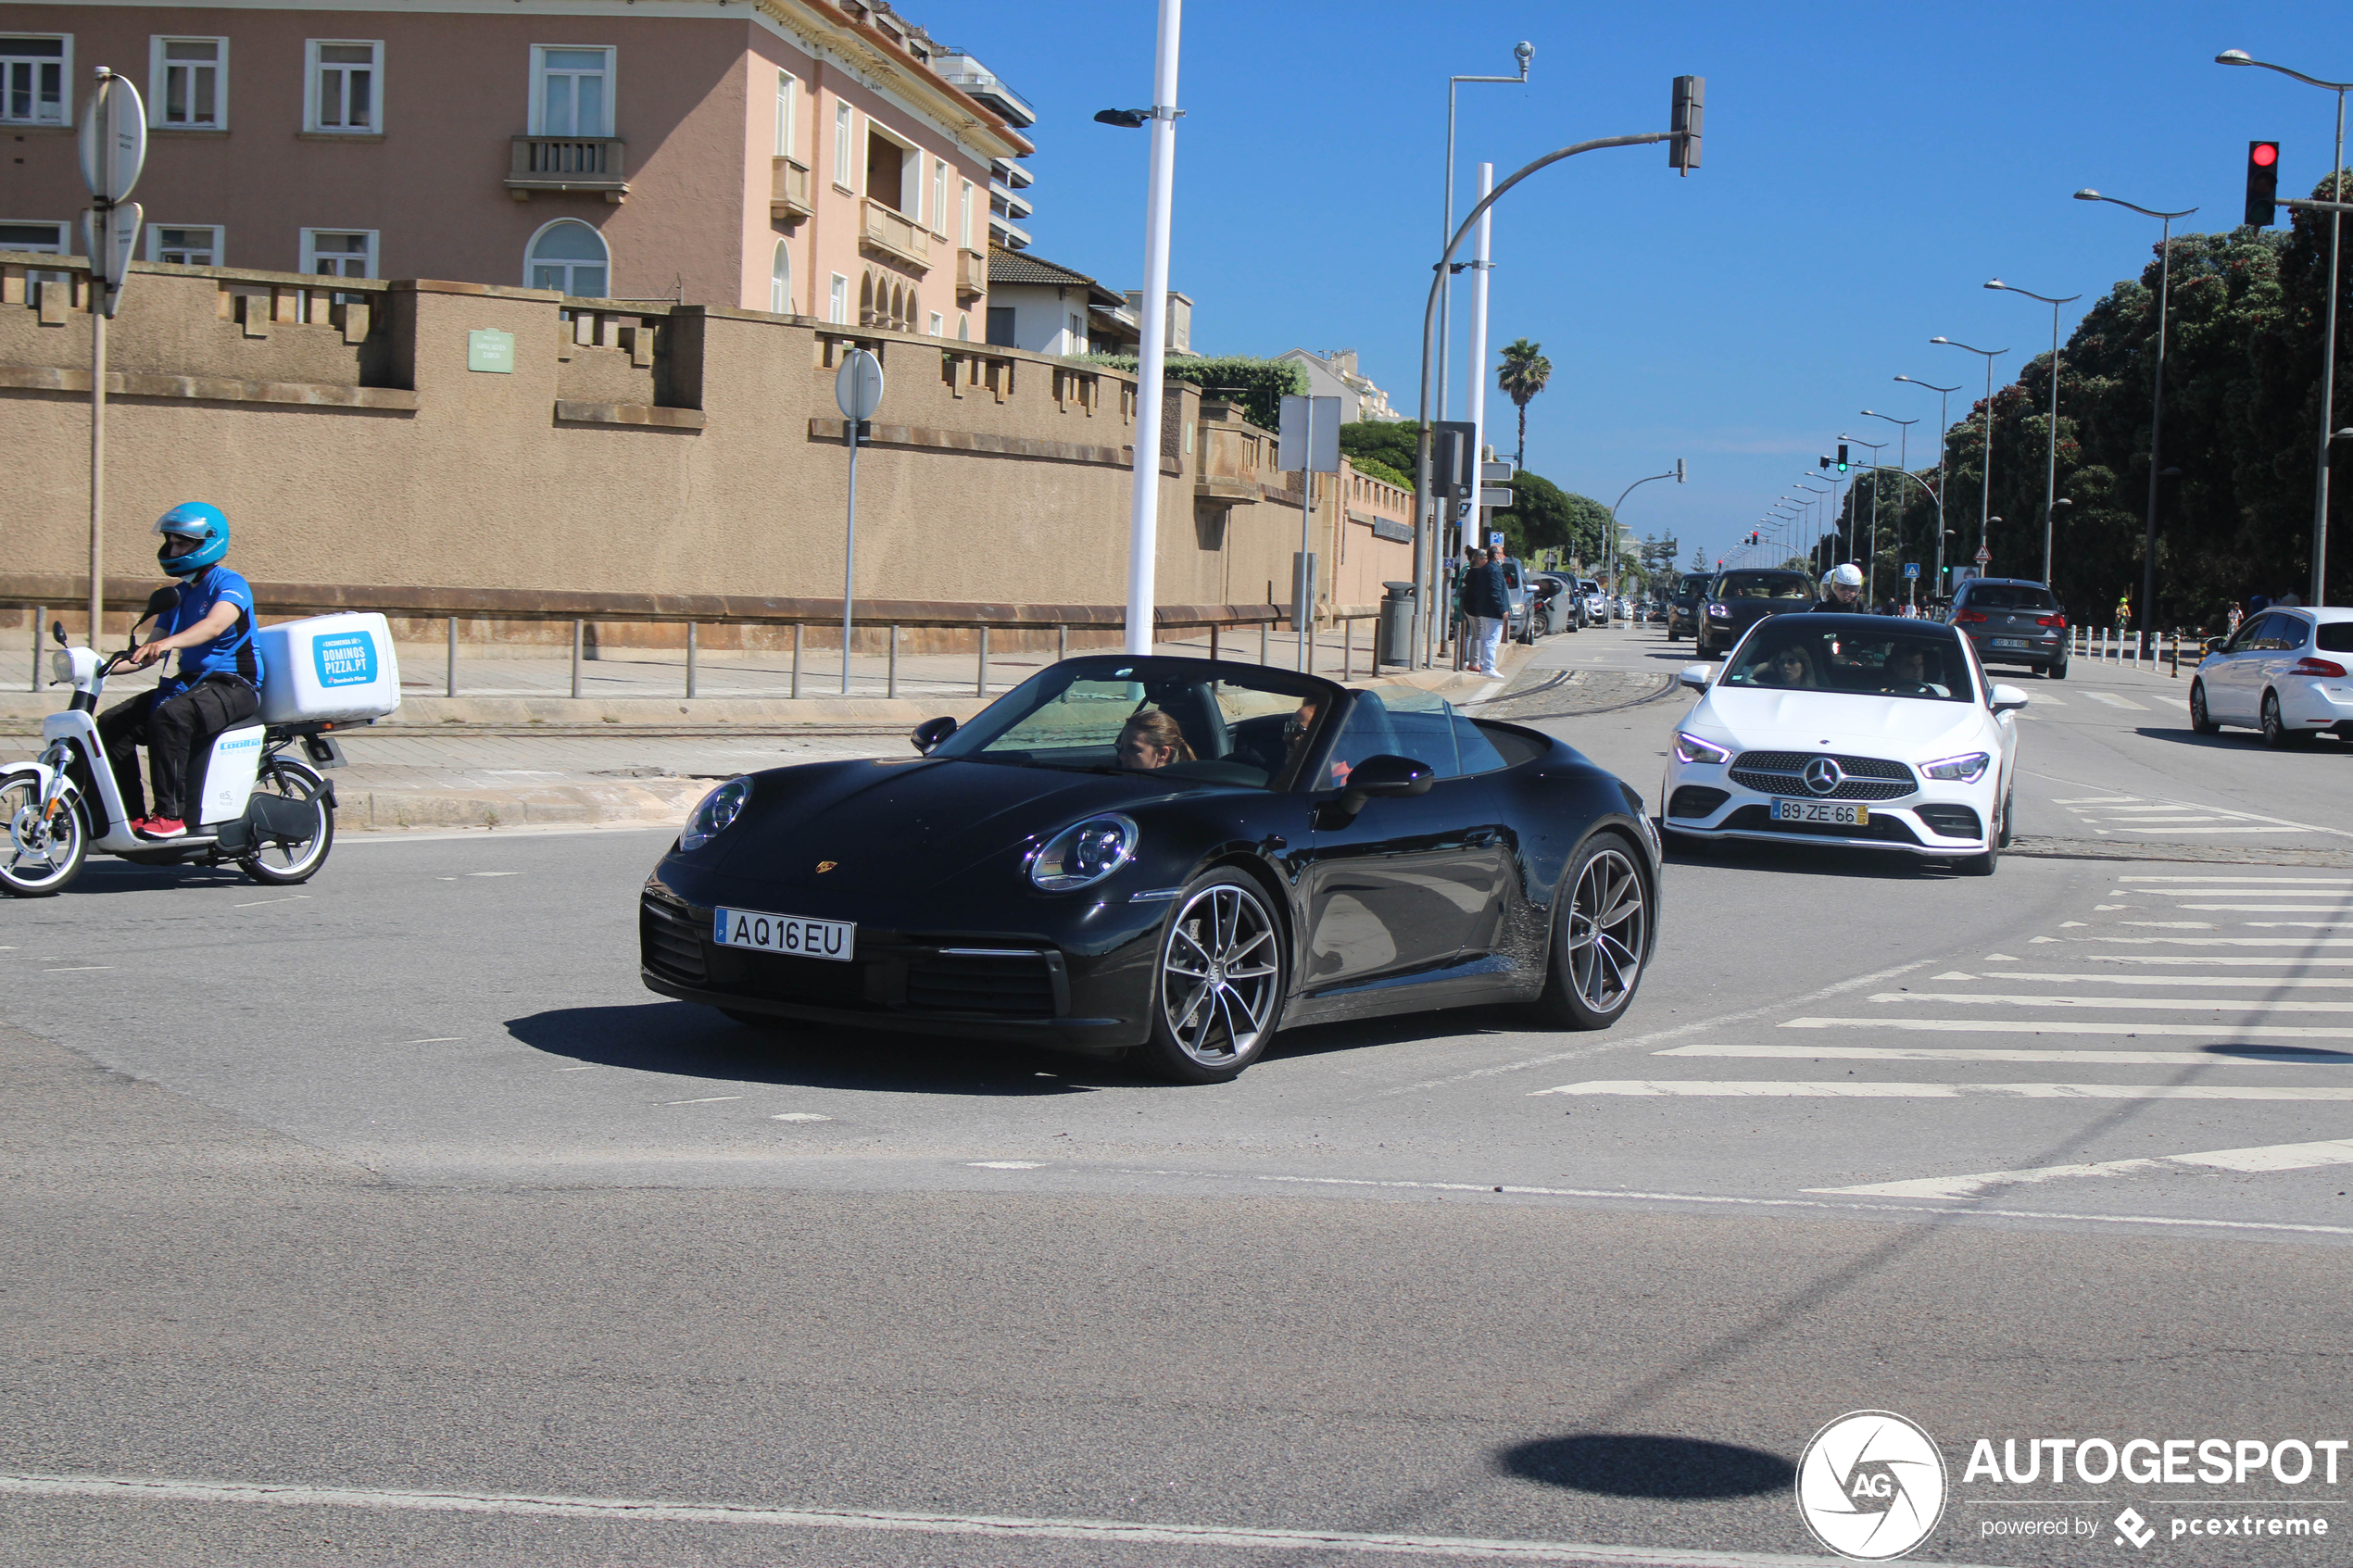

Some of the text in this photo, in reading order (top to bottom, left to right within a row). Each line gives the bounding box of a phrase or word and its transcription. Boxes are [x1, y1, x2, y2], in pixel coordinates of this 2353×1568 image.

[322, 646, 366, 661] DOMINOS
[324, 659, 367, 674] PIZZA.PT
[220, 738, 260, 750] Cooltra
